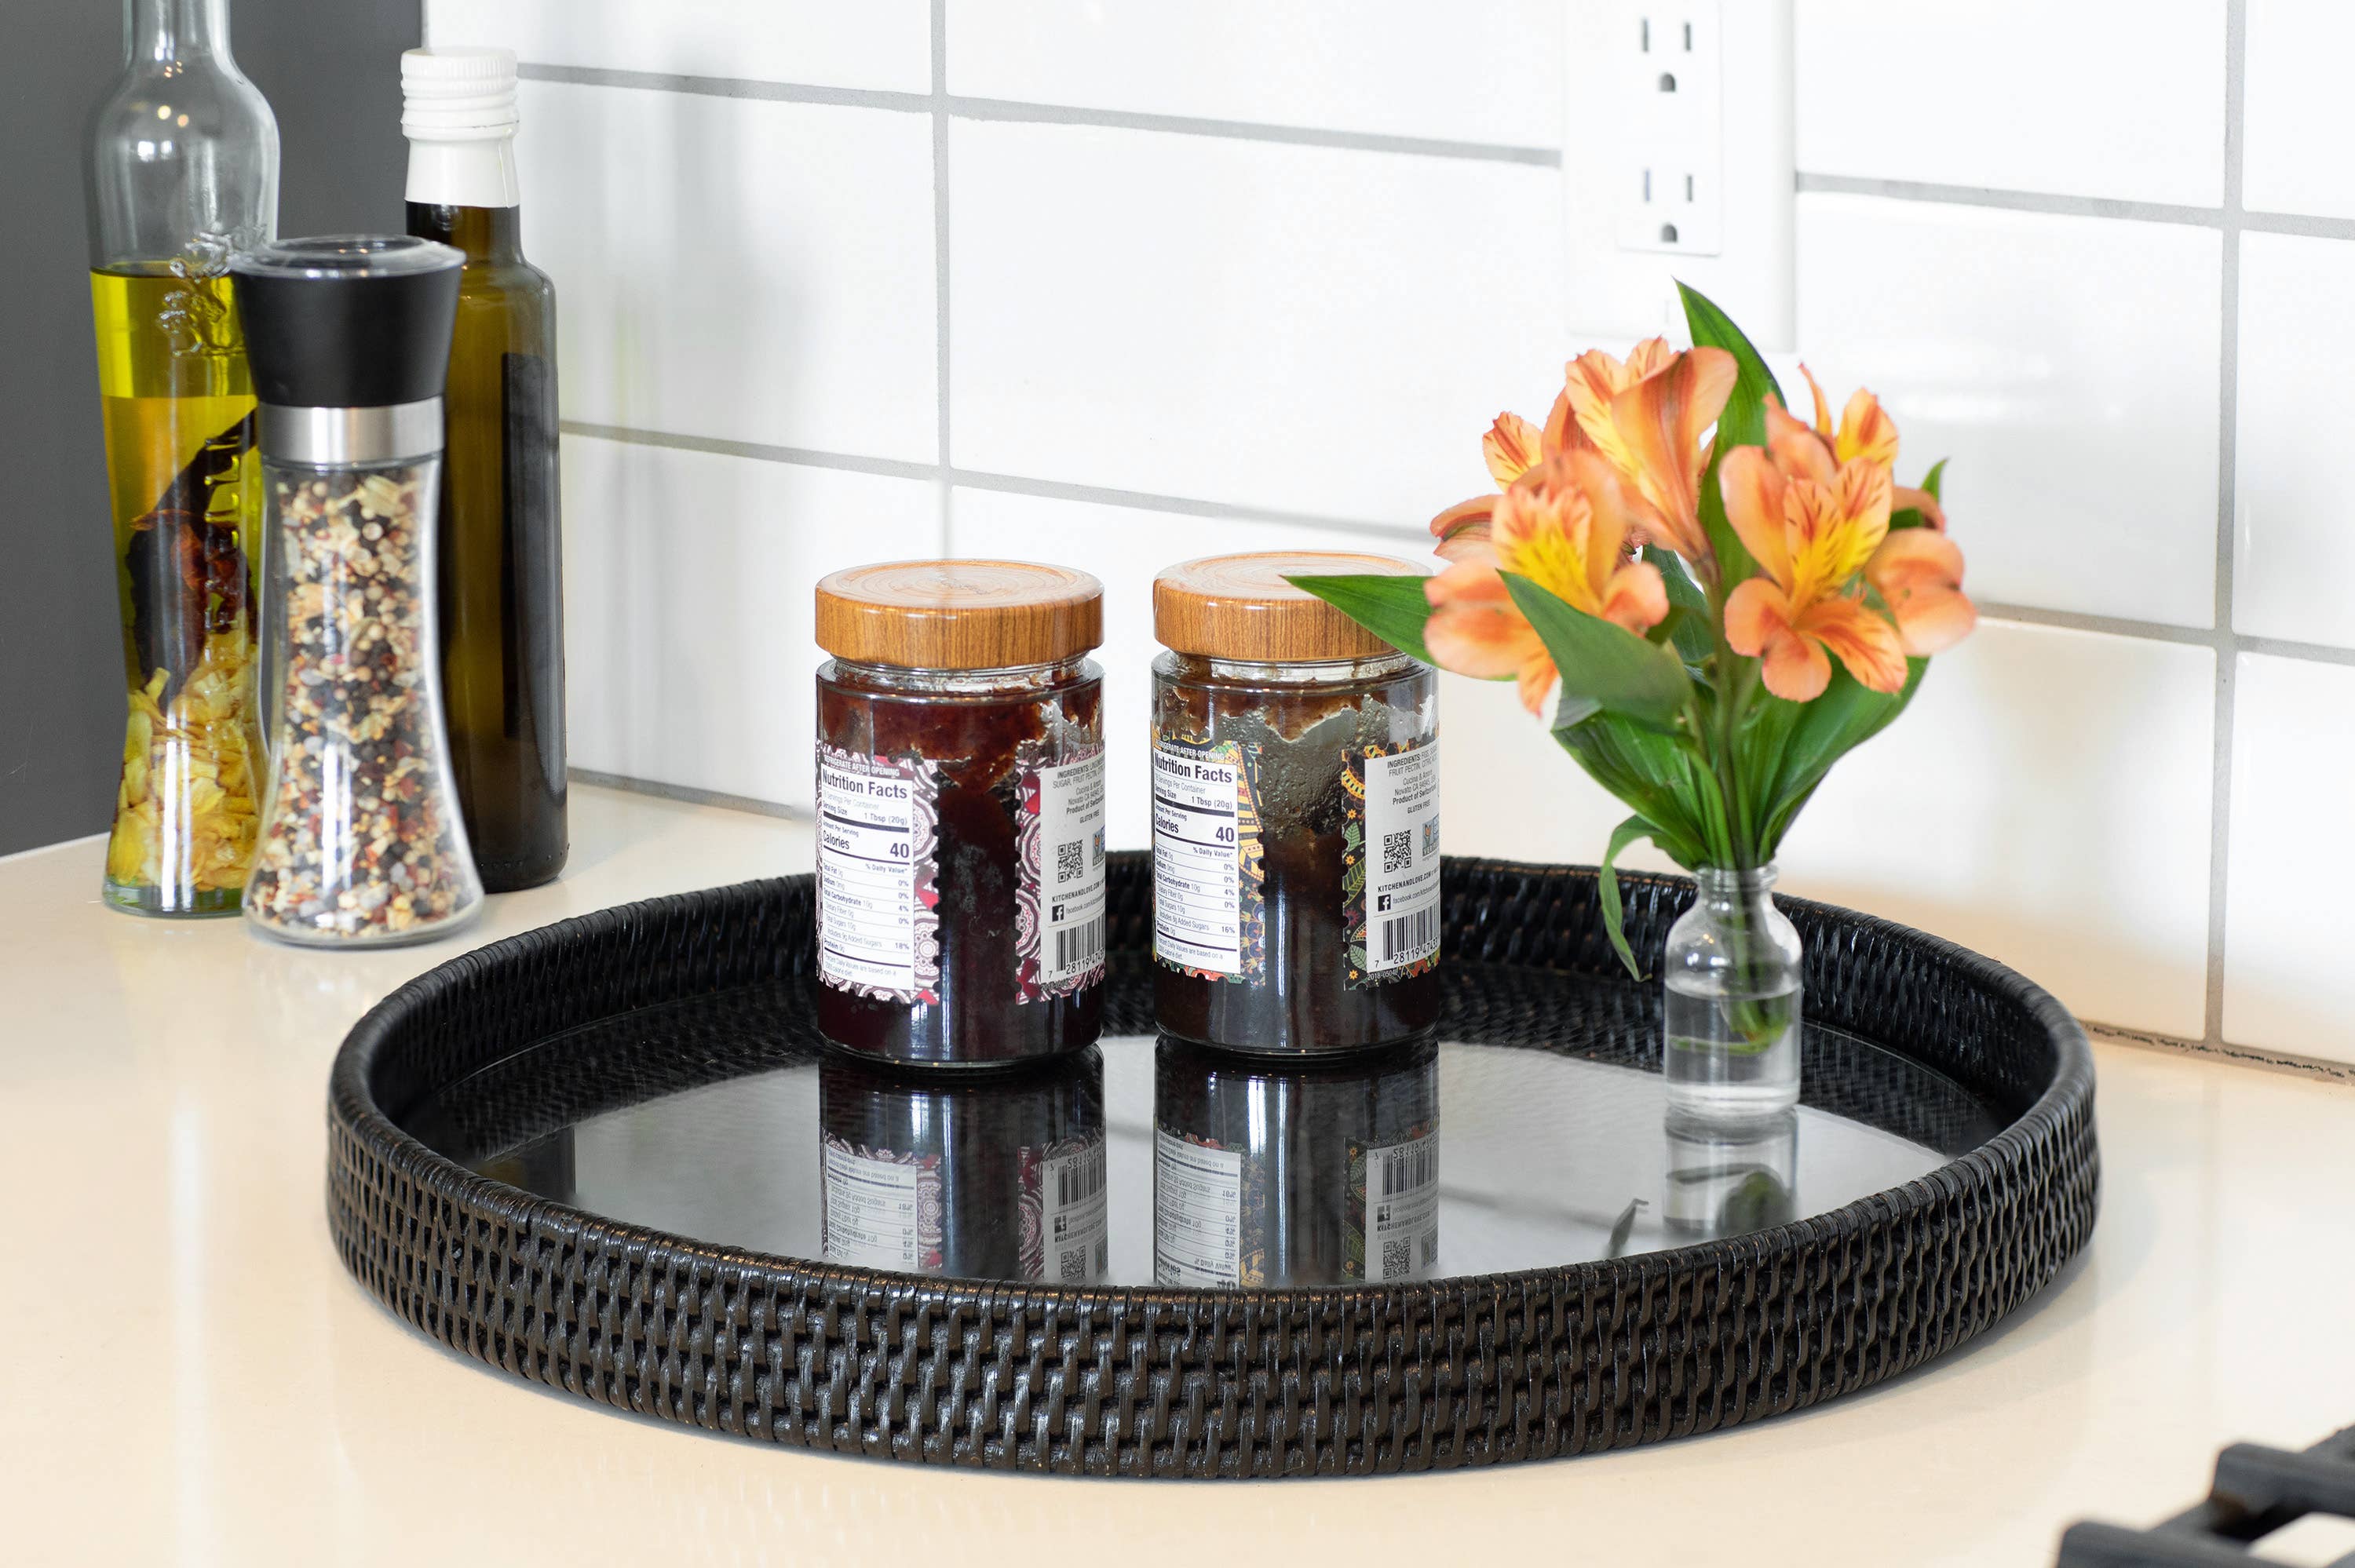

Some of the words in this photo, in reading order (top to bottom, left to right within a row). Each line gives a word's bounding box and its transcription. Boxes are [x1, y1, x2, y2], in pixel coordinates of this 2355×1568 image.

[1181, 746, 1196, 757] AFTER
[1197, 749, 1225, 760] OPENING
[853, 763, 871, 773] AFTER
[871, 765, 900, 777] OPENING
[1155, 752, 1191, 778] Nutrition
[1195, 765, 1232, 783] Facts
[823, 768, 863, 794] Nutrition
[868, 782, 907, 798] Facts
[1181, 782, 1206, 793] Container
[1393, 793, 1413, 805] Product
[1414, 791, 1418, 800] of
[1394, 786, 1411, 797] Novato
[1167, 789, 1177, 799] Size
[1196, 797, 1211, 807] Tbsp
[1214, 800, 1232, 810] (20g)
[1066, 803, 1084, 815] Product
[1171, 808, 1187, 821] Serving
[1407, 803, 1422, 814] GLUTEN
[870, 813, 886, 823] Tbsp
[1156, 813, 1179, 833] Calories
[1215, 826, 1235, 842] 40
[823, 830, 849, 850] Calories
[889, 843, 909, 859] 40
[1199, 848, 1212, 857] Daily
[1163, 874, 1190, 890] Carbohydrate
[1191, 883, 1200, 893] 10g
[1178, 917, 1192, 927] Added
[1192, 920, 1210, 931] Sugars
[1393, 947, 1420, 965] 28119
[1049, 971, 1053, 979] 7
[1066, 957, 1090, 975] 28119
